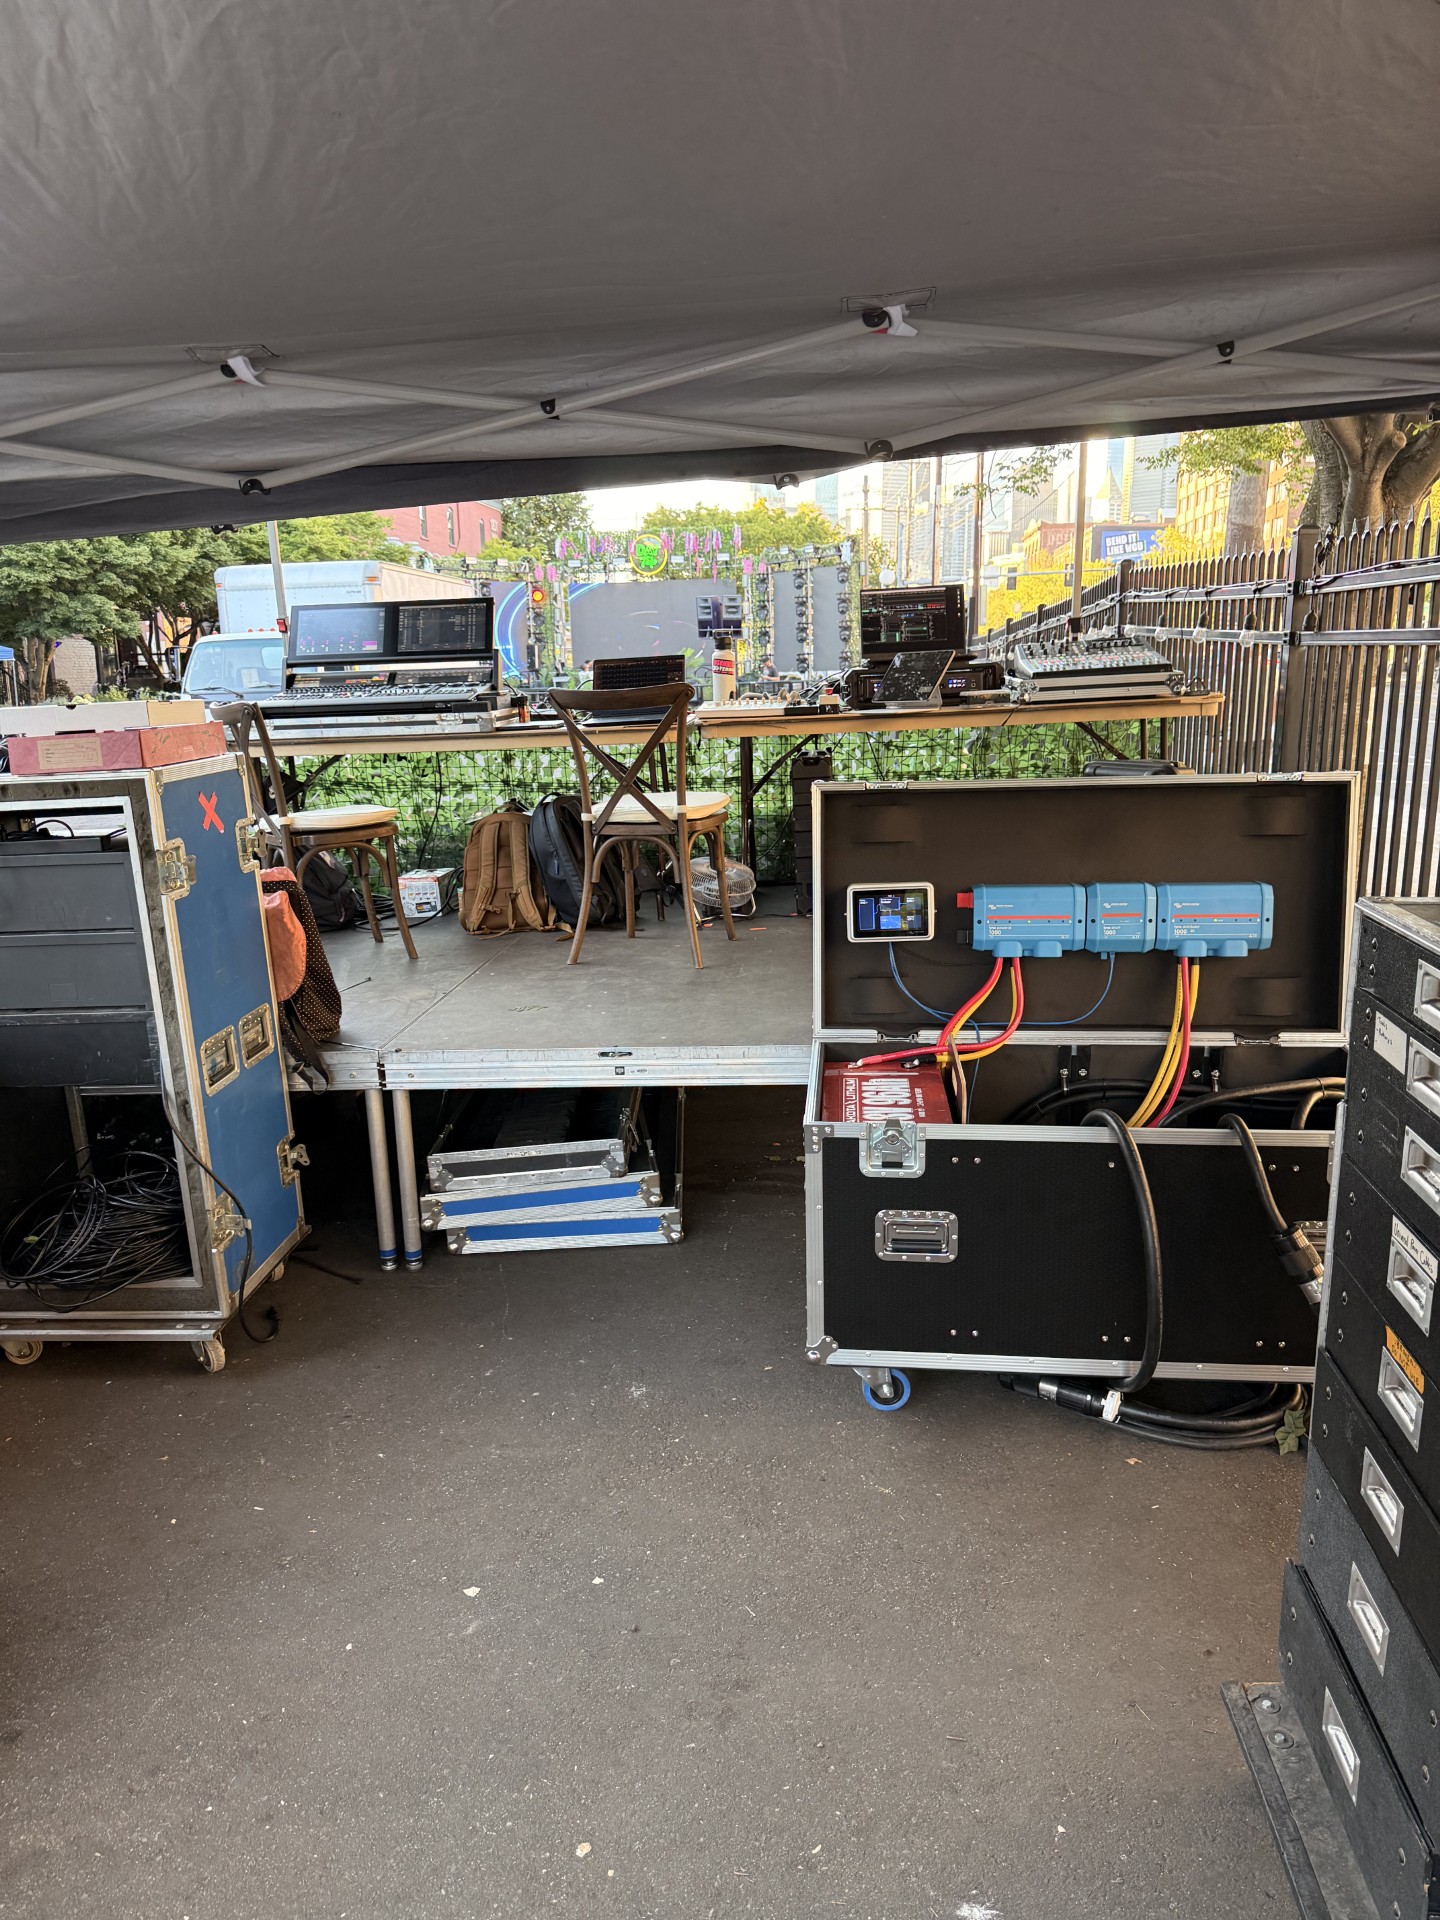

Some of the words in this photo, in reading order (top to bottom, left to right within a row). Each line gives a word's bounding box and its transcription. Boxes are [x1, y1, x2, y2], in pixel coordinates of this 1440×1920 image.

[1105, 534, 1128, 547] BEND
[1128, 533, 1137, 544] IT
[636, 543, 659, 557] DAY
[1106, 544, 1125, 556] LIKE
[861, 1078, 912, 1105] 96Ah
[845, 1104, 857, 1123] AKOTA
